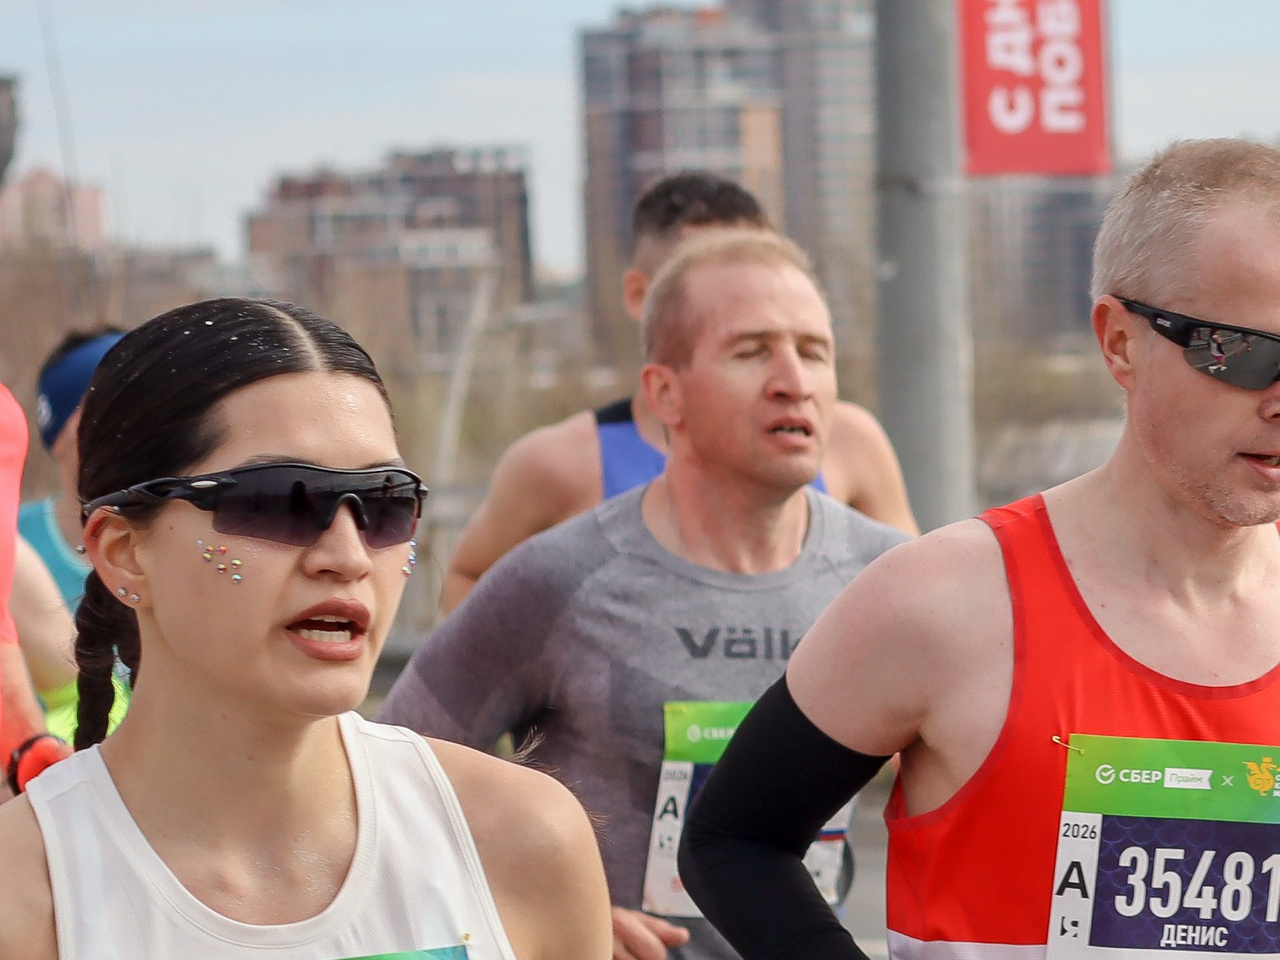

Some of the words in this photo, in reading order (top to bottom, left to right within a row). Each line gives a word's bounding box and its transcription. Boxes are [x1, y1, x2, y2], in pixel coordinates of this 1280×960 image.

[1118, 769, 1162, 784] СБЕР
[1062, 823, 1097, 840] 2026
[1160, 923, 1229, 948] ДЕНИС
